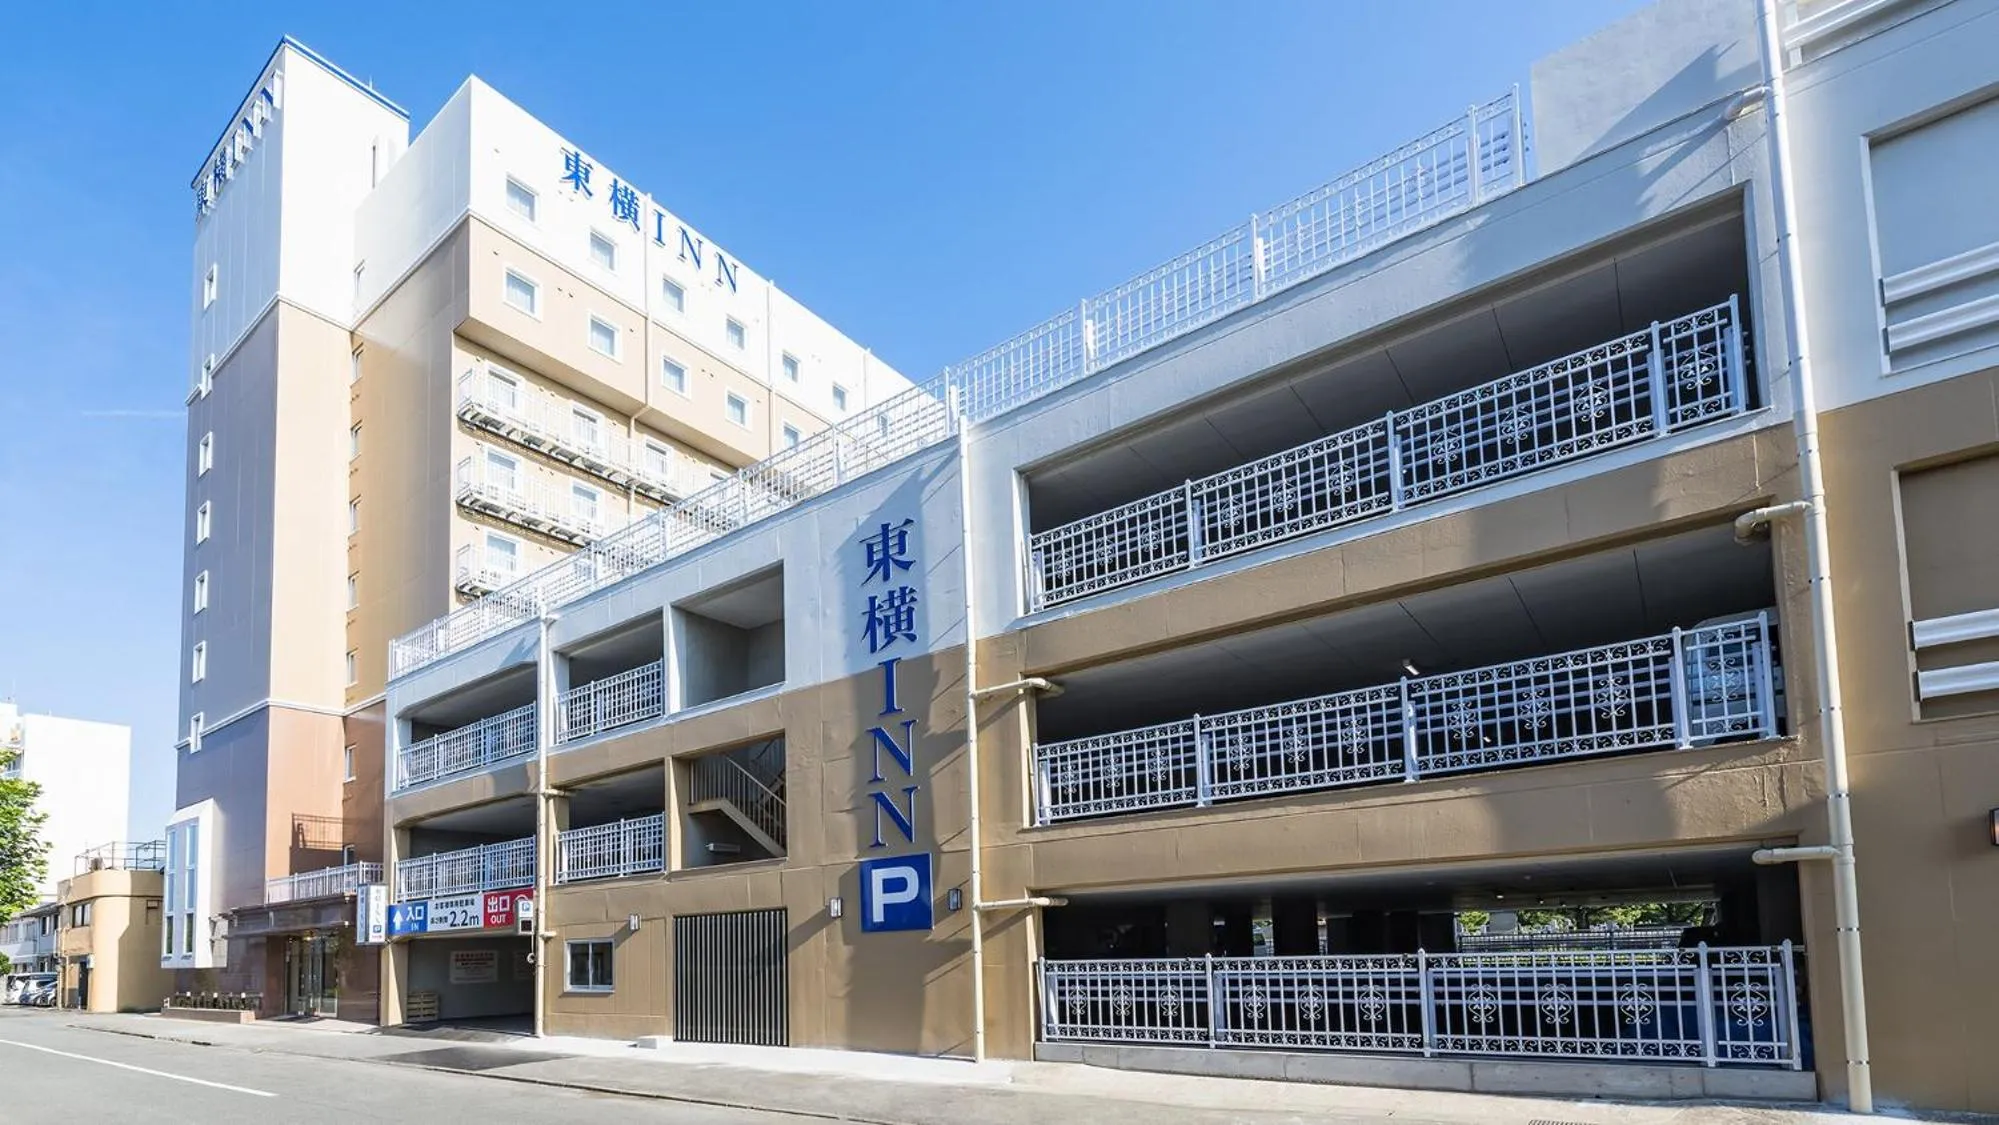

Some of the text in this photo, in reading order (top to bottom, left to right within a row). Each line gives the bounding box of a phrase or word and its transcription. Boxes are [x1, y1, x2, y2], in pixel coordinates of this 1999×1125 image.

[559, 147, 739, 294] 東横INN
[859, 518, 920, 848] 東横INN
[871, 866, 920, 924] P
[488, 895, 510, 913] 出口
[406, 905, 424, 921] 入口
[450, 910, 480, 927] 2.2m
[491, 914, 506, 924] OUT
[411, 922, 420, 930] IN
